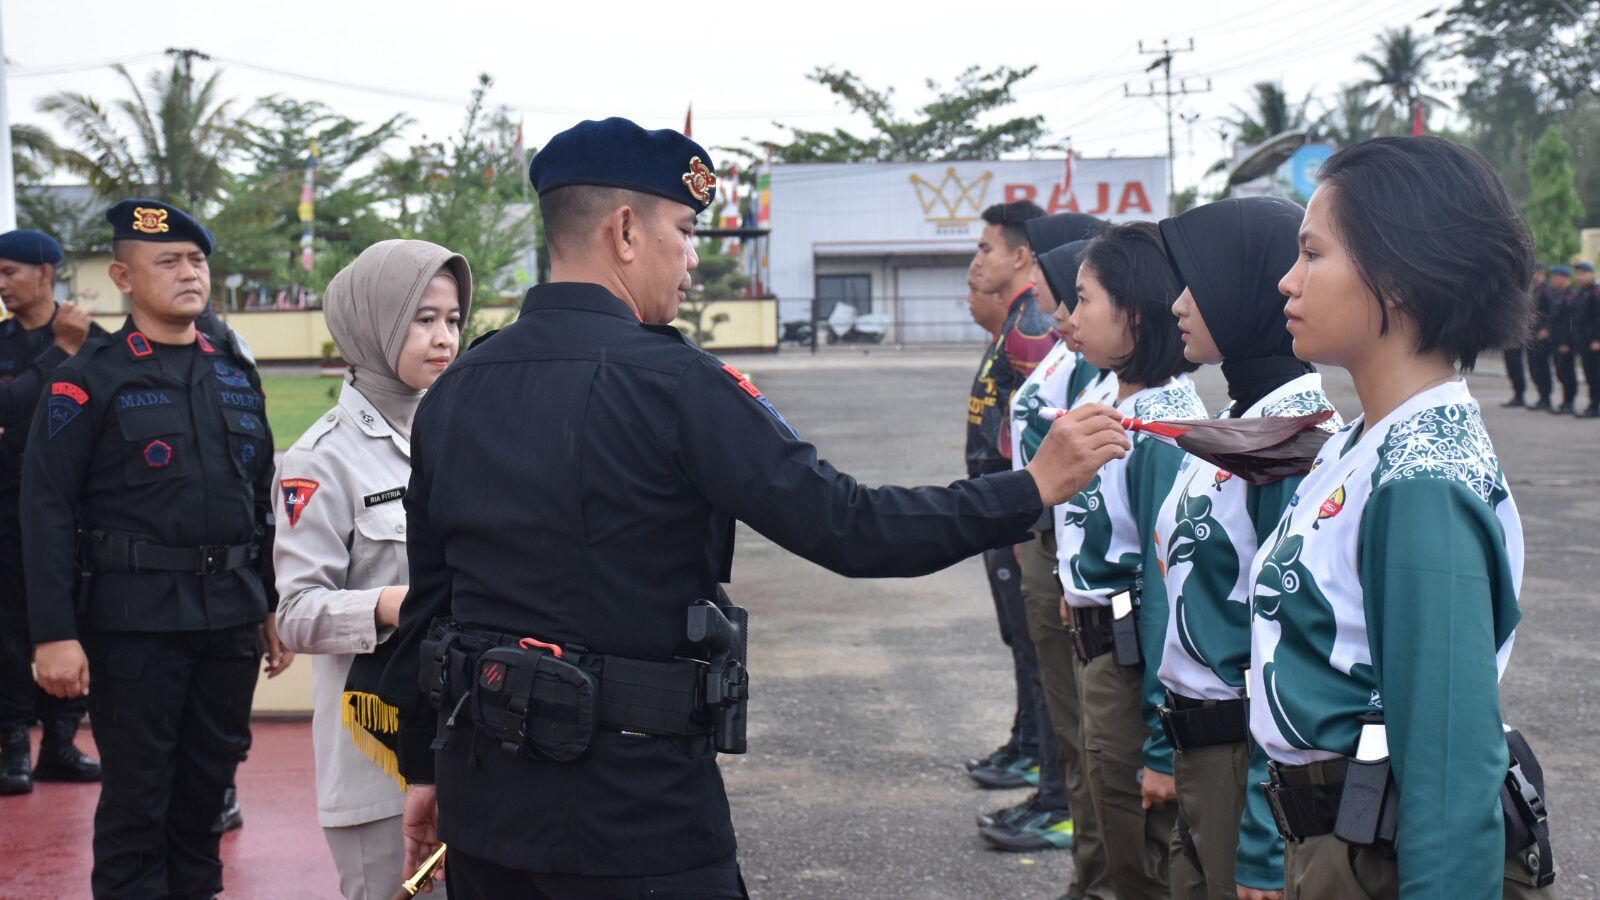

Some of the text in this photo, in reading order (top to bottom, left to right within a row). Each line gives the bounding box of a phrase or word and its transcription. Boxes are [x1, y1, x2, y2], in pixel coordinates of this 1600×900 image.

[1004, 181, 1152, 215] RAJA
[119, 391, 171, 408] MADA
[220, 391, 259, 409] POLRI
[370, 489, 401, 503] RIA FITRIA
